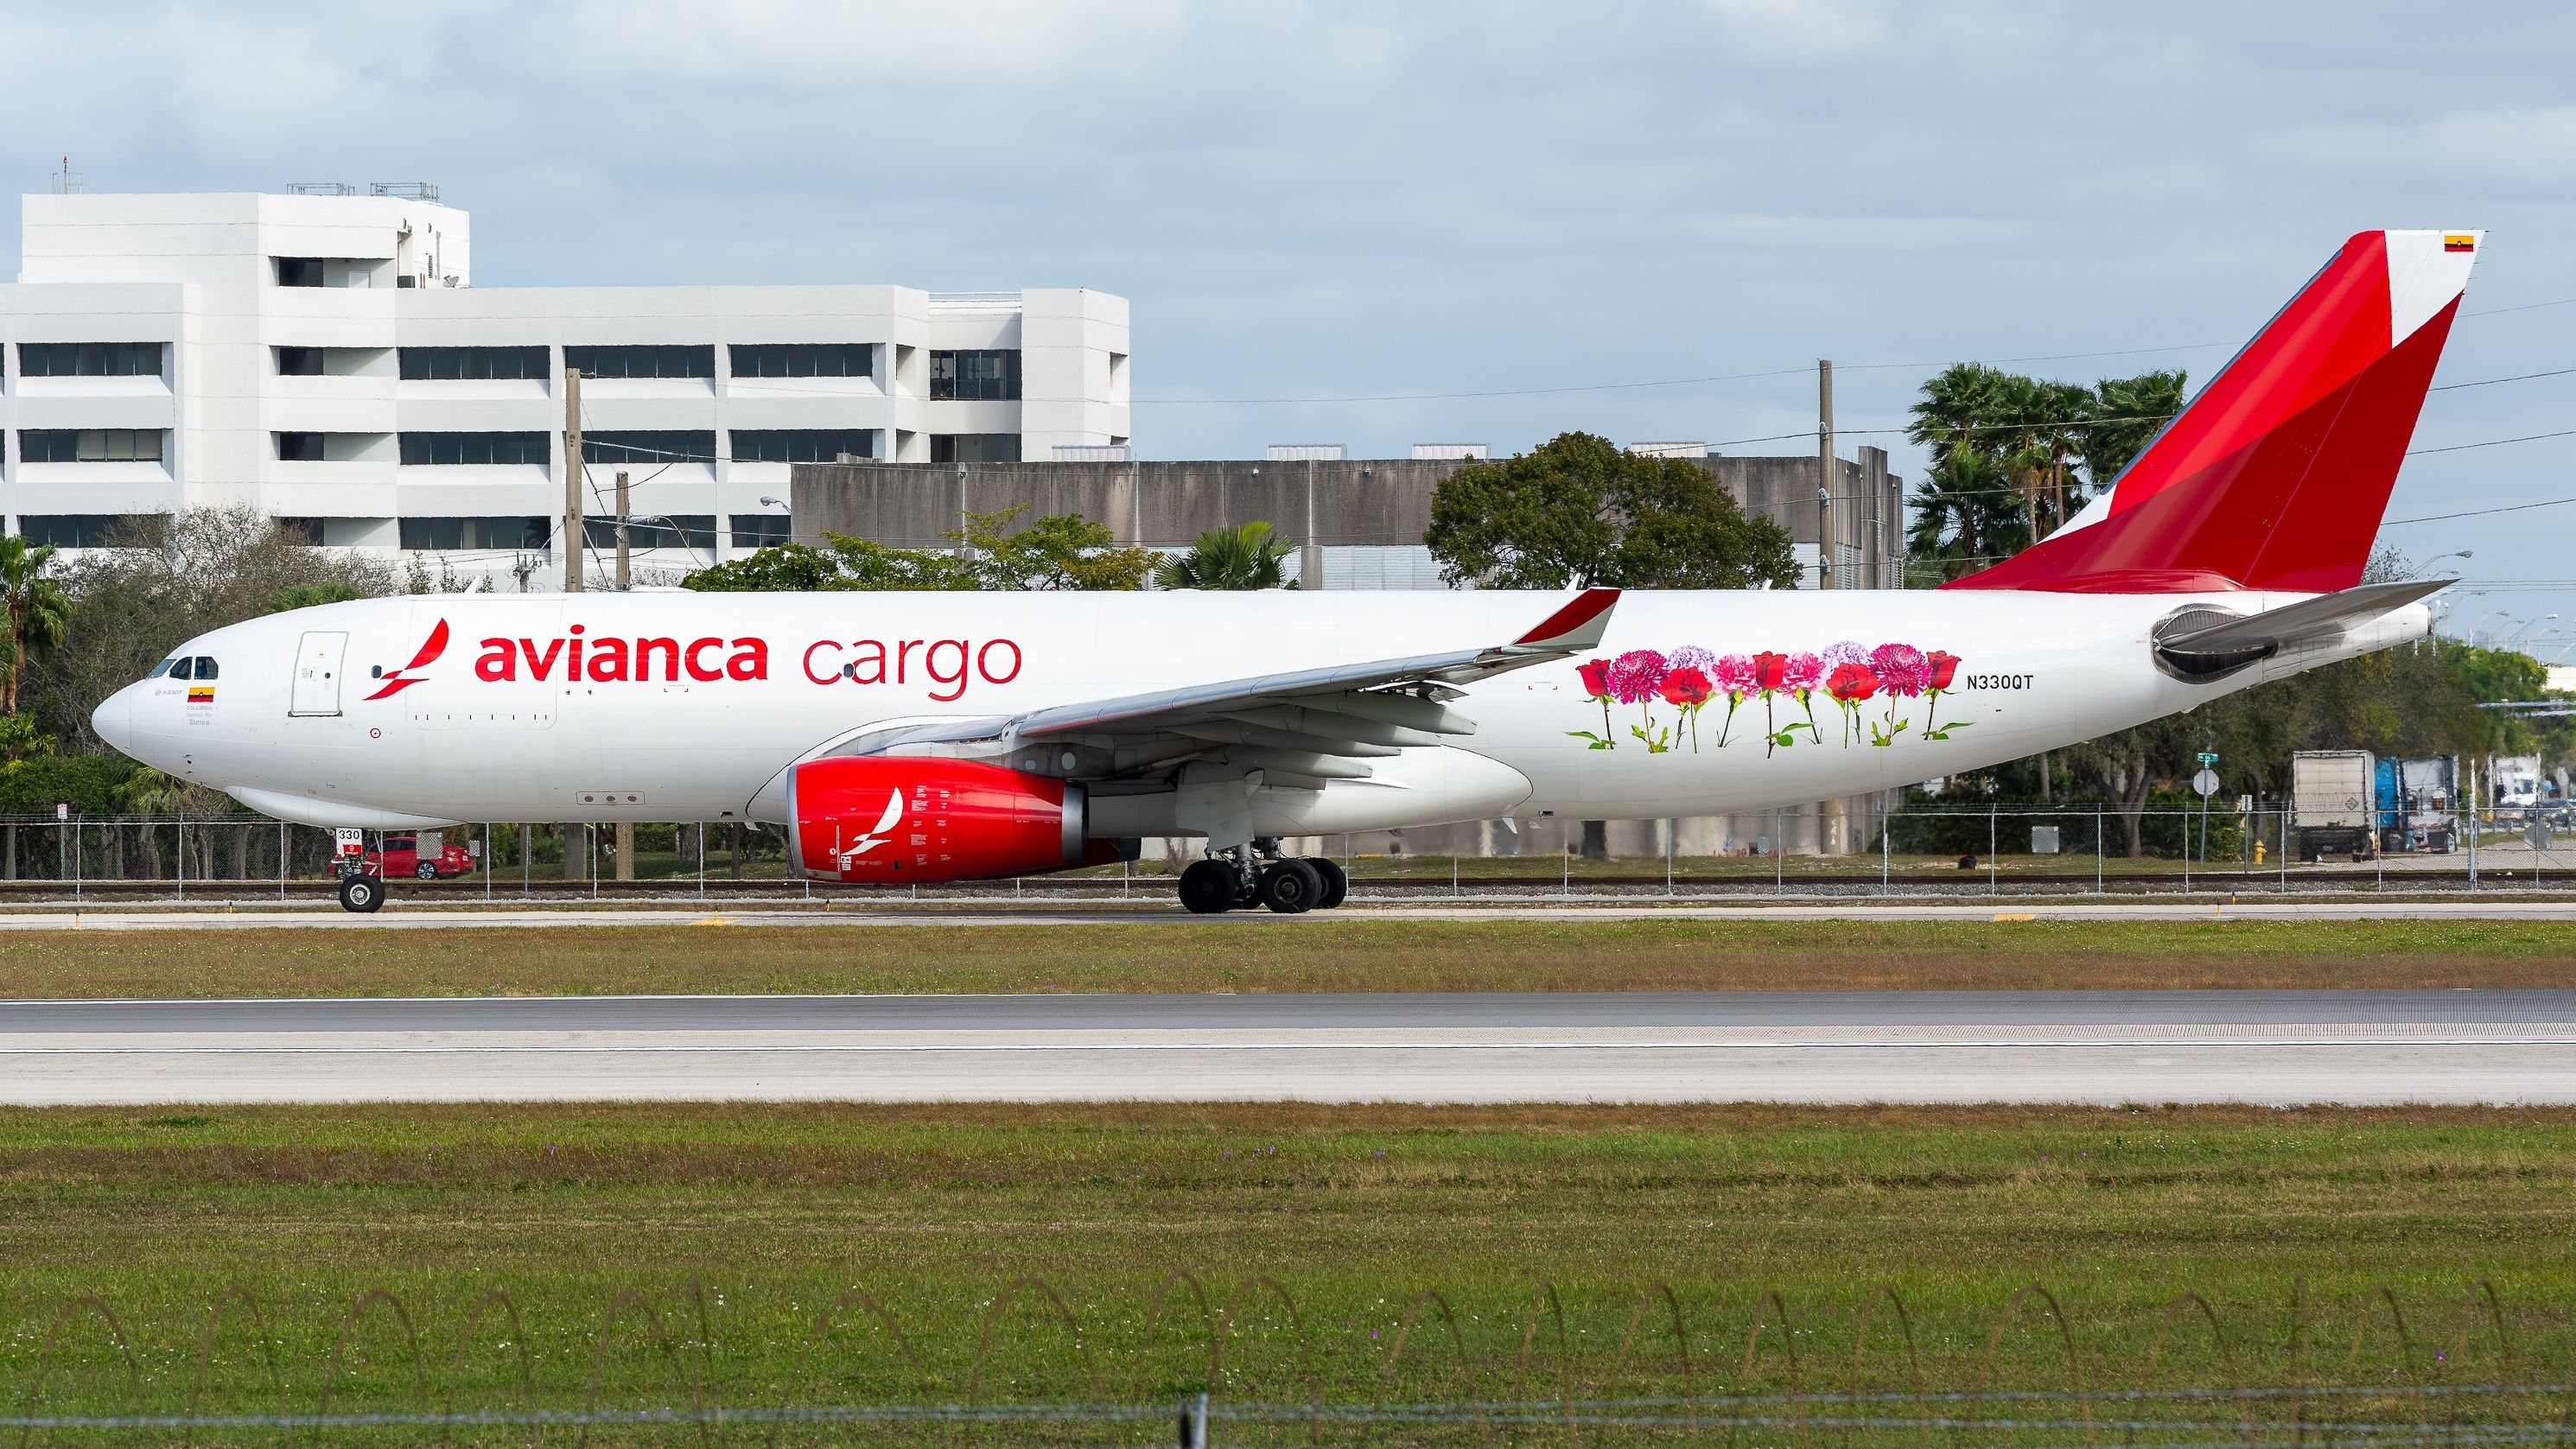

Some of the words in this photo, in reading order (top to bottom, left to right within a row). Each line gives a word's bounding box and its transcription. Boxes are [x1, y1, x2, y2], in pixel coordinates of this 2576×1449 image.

[475, 625, 768, 683] avianca
[803, 639, 1023, 702] cargo
[1967, 675, 2033, 690] N330QT
[339, 830, 359, 839] 330
